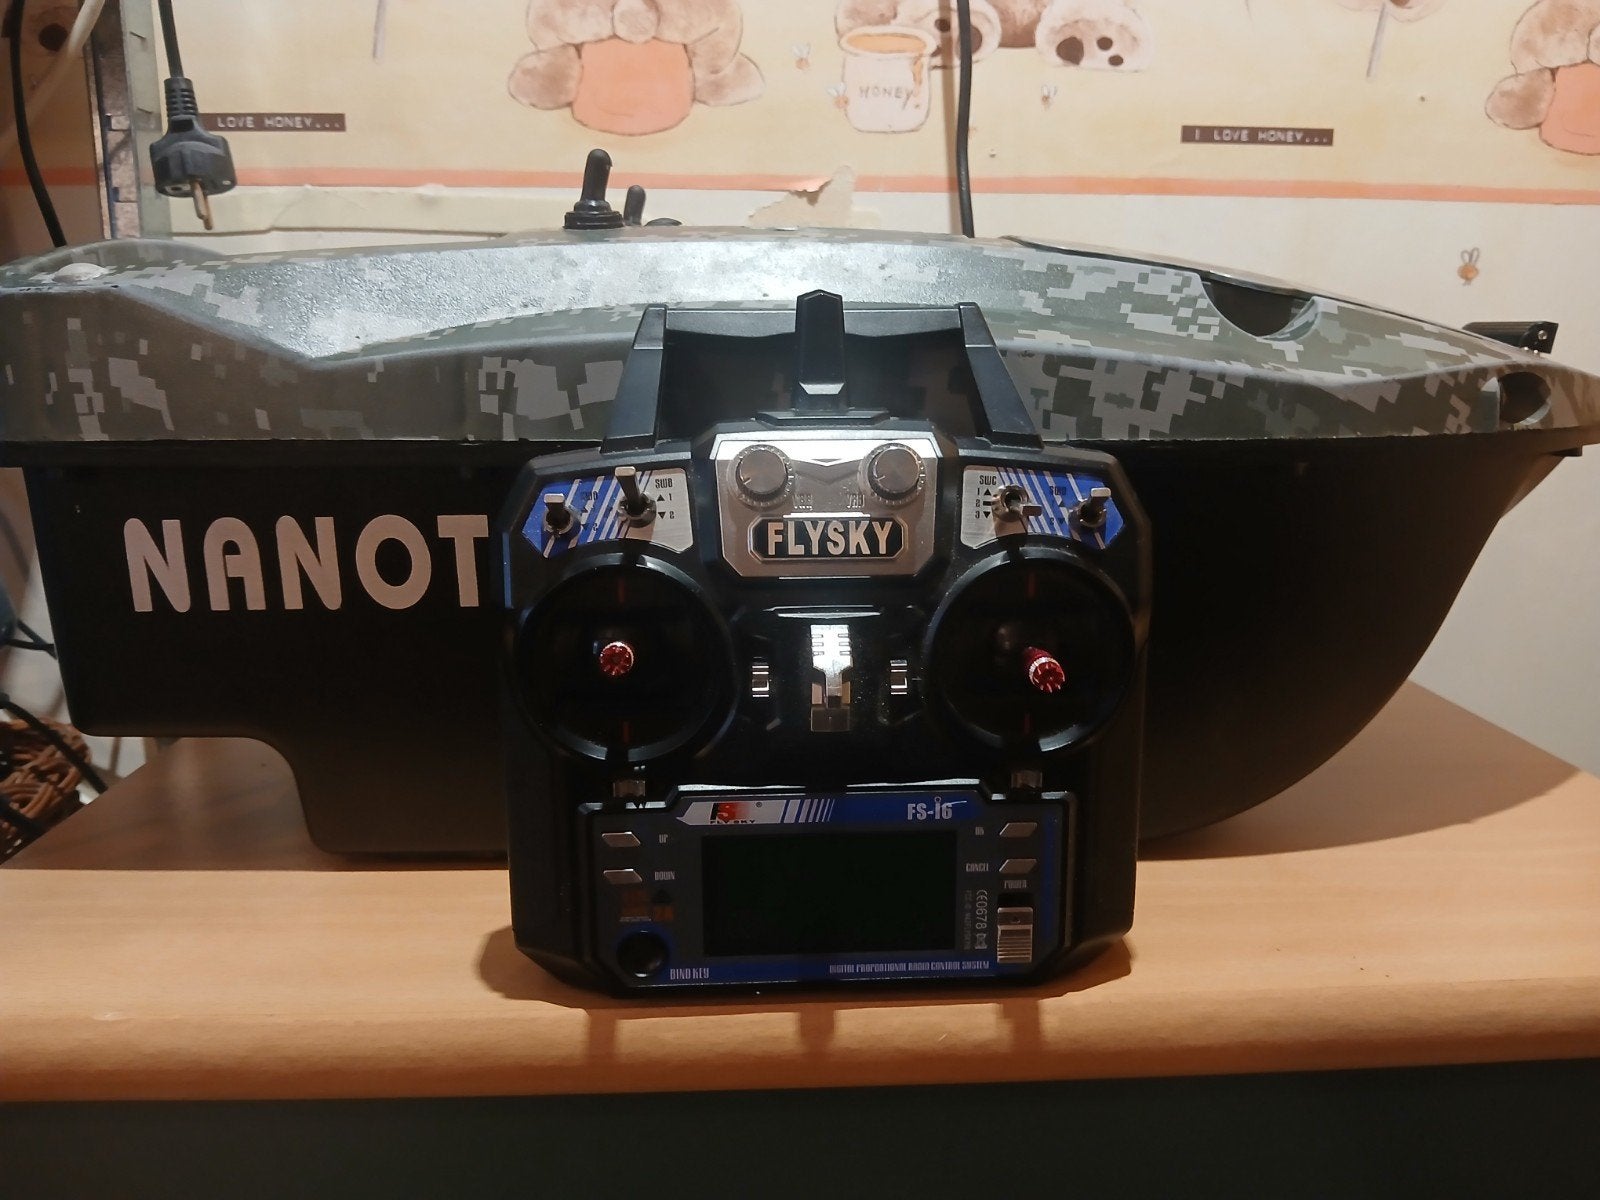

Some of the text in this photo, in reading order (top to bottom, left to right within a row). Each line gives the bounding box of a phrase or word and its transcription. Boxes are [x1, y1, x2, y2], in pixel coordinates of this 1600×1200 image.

[858, 86, 914, 110] HONEY
[216, 116, 255, 128] LOVE
[1194, 127, 1201, 141] I
[1213, 129, 1249, 142] LOVE
[978, 475, 997, 486] SWC
[767, 520, 893, 556] FLYSKY
[123, 513, 489, 613] NANOT
[658, 833, 669, 844] UP
[654, 871, 676, 881] DOWN
[670, 967, 710, 980] BIND KEY
